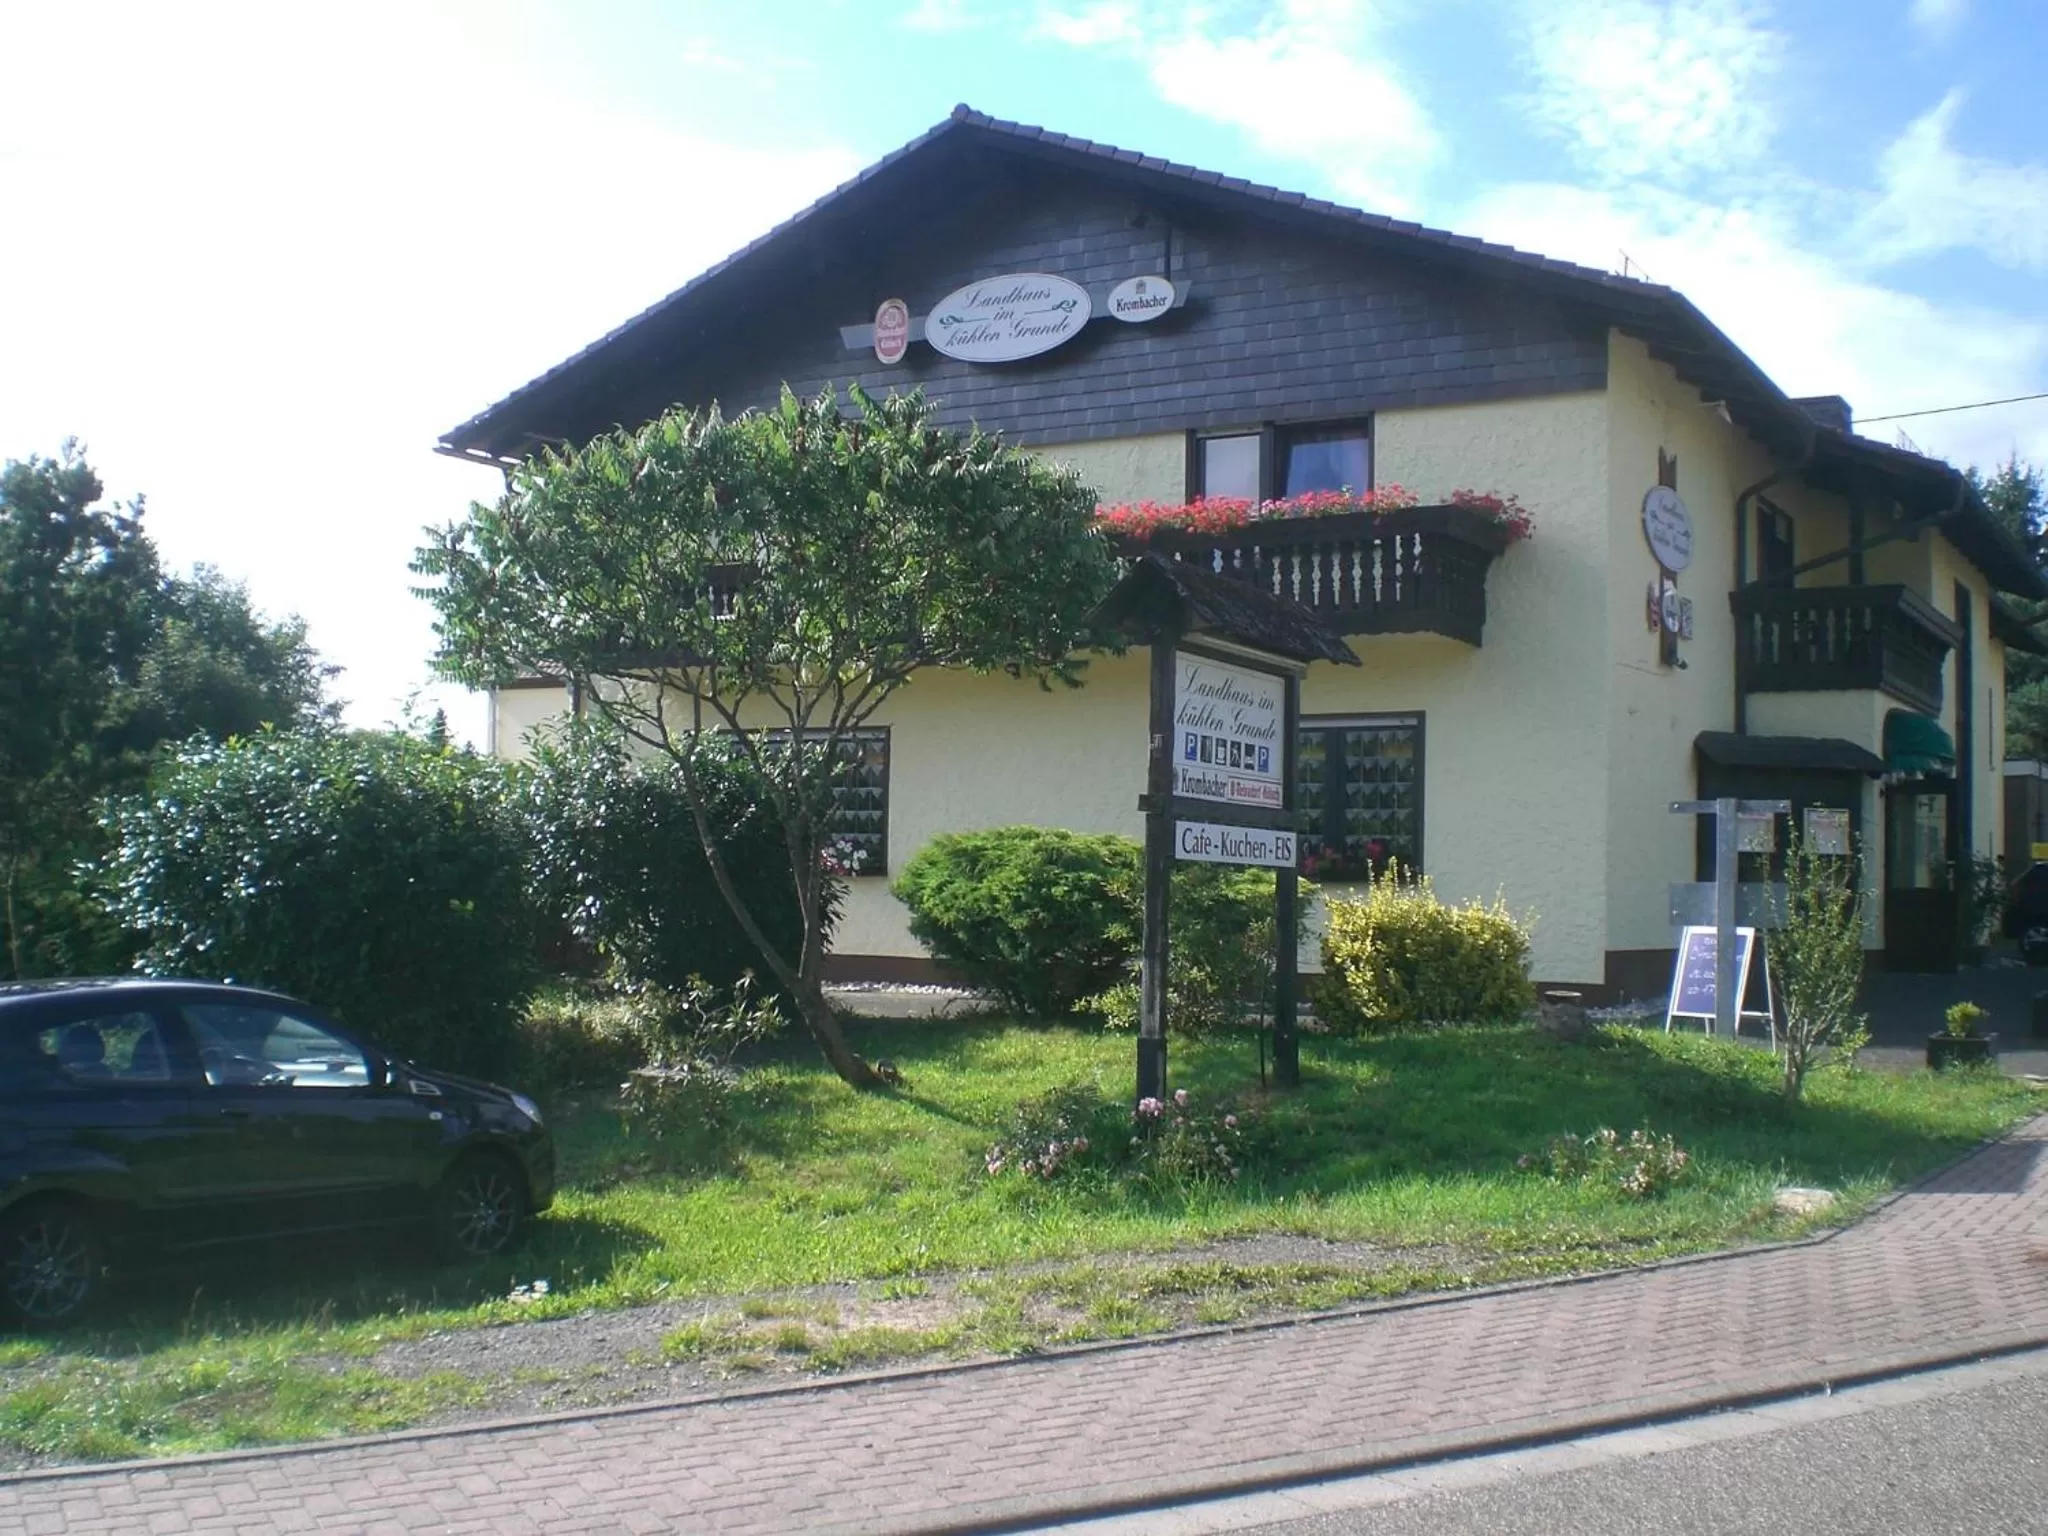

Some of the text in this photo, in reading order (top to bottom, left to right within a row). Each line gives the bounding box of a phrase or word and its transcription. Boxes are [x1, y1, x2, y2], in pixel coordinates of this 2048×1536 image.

[964, 281, 1052, 309] Landhaus
[1115, 295, 1168, 312] Krombacher
[994, 307, 1014, 320] im
[944, 317, 1071, 348] kühlen Grunde
[1180, 664, 1275, 711] Landhaus im
[1176, 699, 1276, 740] kühlen Grunde
[1182, 768, 1226, 797] Krombacher
